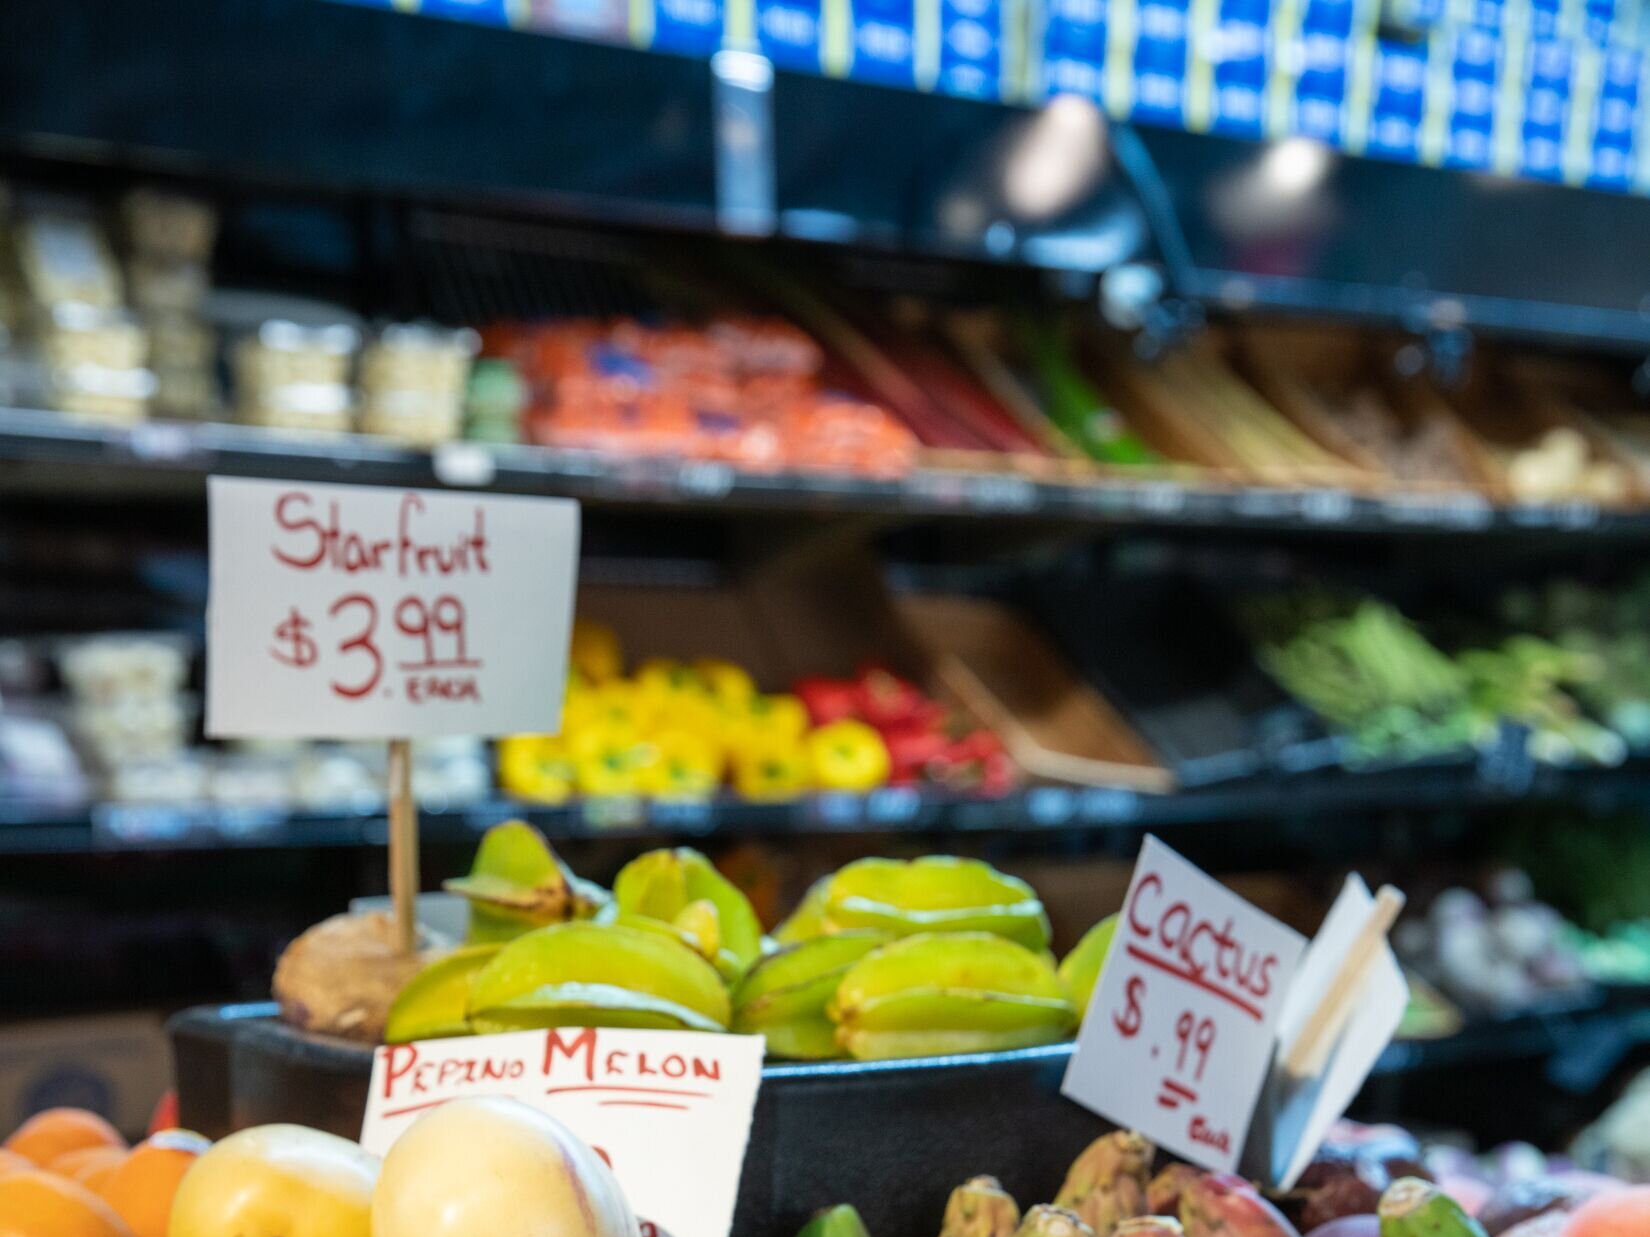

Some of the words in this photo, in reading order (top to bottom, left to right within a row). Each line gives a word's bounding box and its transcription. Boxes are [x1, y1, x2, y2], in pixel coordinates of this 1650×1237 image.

[271, 491, 489, 577] Starfruit
[1128, 872, 1279, 999] Cactus
[542, 1027, 721, 1081] MELON
